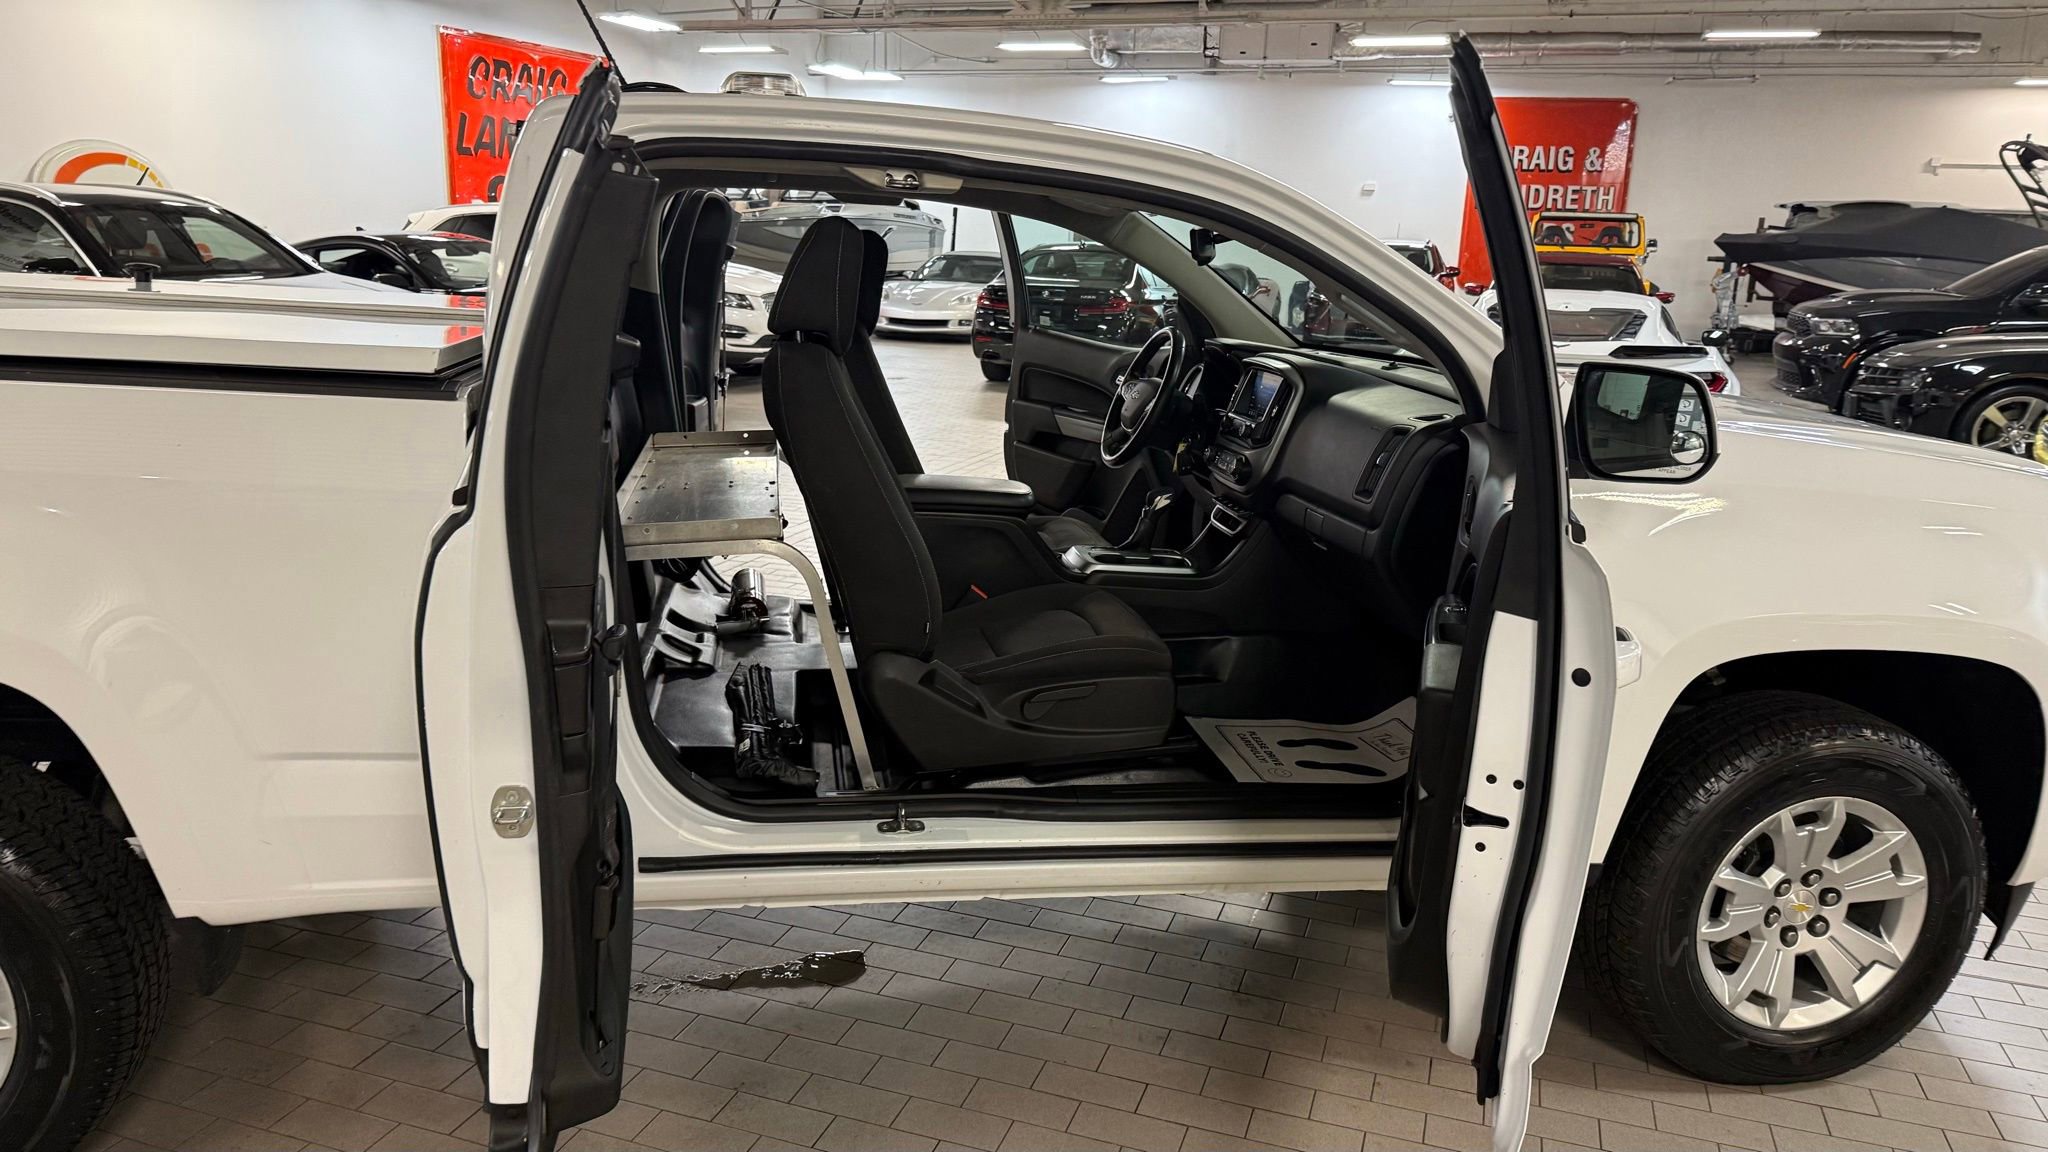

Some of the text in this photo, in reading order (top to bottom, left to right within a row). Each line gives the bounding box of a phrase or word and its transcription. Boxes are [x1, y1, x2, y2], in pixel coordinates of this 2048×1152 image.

[1511, 145, 1603, 173] RAIG &
[1520, 183, 1615, 211] DRETH
